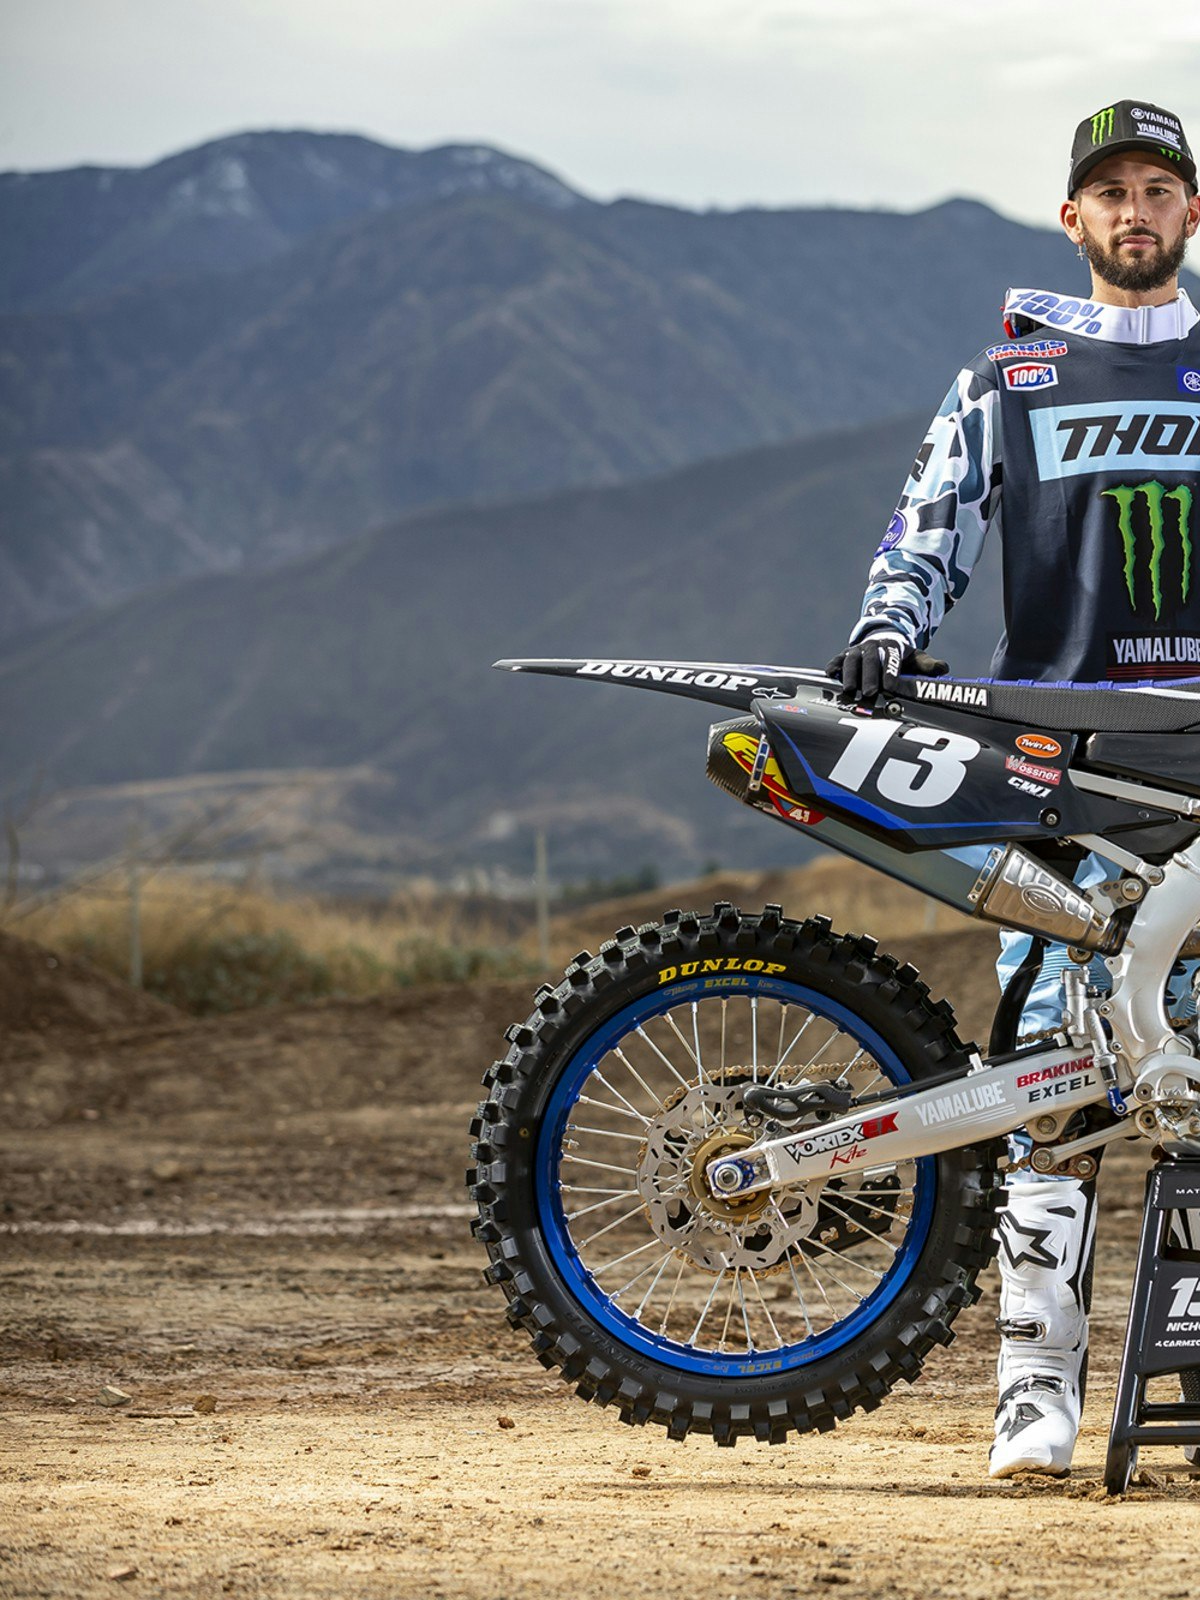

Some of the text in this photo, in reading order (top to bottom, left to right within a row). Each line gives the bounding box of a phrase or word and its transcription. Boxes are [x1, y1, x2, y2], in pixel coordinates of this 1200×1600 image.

[1137, 122, 1180, 144] YAMALUBE
[1144, 111, 1180, 132] YAMAHA
[1007, 291, 1104, 335] 100%
[1011, 368, 1050, 385] 100%
[576, 661, 760, 691] DUNLOP
[886, 646, 899, 677] THOR
[915, 681, 988, 707] YAMAHA
[1021, 738, 1058, 752] Twin Air
[828, 717, 981, 808] 13
[658, 957, 787, 985] DUNLOP
[704, 977, 749, 988] EXCEL
[1016, 1055, 1094, 1089] BRAKING
[1028, 1074, 1096, 1103] EXCEL
[914, 1081, 1006, 1127] YAMALUBE
[784, 1123, 865, 1164] VORTEX
